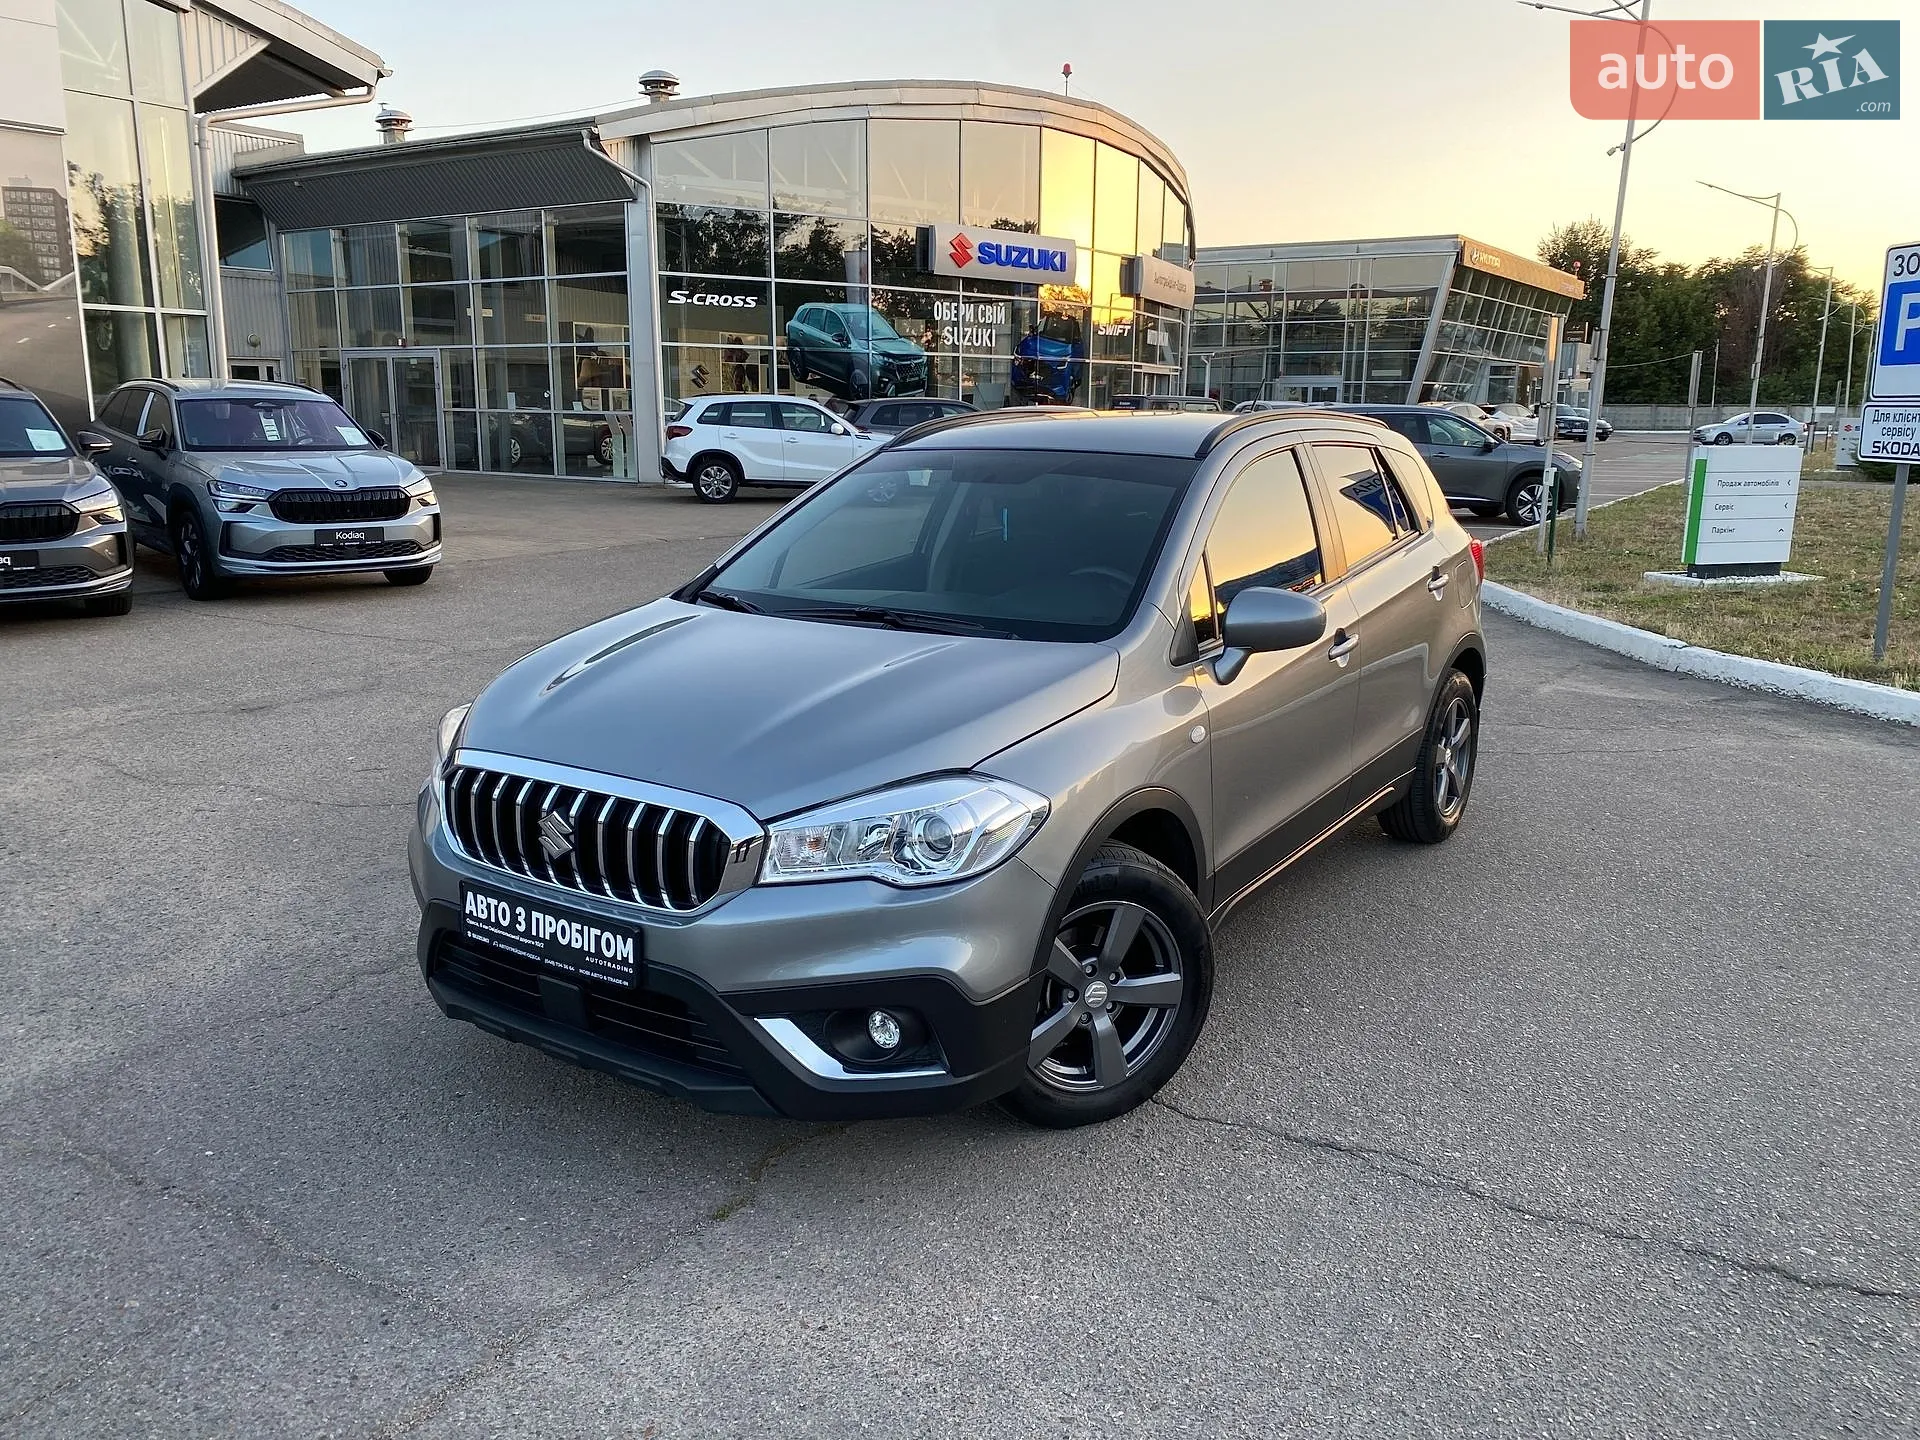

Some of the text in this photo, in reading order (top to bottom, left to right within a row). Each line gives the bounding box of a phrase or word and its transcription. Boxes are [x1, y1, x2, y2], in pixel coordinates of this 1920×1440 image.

[977, 241, 1067, 273] SUZUKI
[933, 300, 1006, 325] ОБЕРИ СВІЙ
[943, 325, 996, 347] SUZUKI
[1097, 323, 1132, 337] SWIFT
[1871, 409, 1891, 424] Для
[1881, 424, 1917, 440] сервісу
[1871, 440, 1920, 457] SKODA
[1717, 479, 1780, 489] Продаж автомобілів
[1714, 503, 1735, 512] Сервіс
[335, 531, 365, 541] Kodiaq
[1711, 526, 1736, 535] Паркінг
[465, 890, 511, 927] АВТО
[531, 910, 634, 964] ПРОБІГОМ
[585, 955, 634, 974] AUTOTRADING
